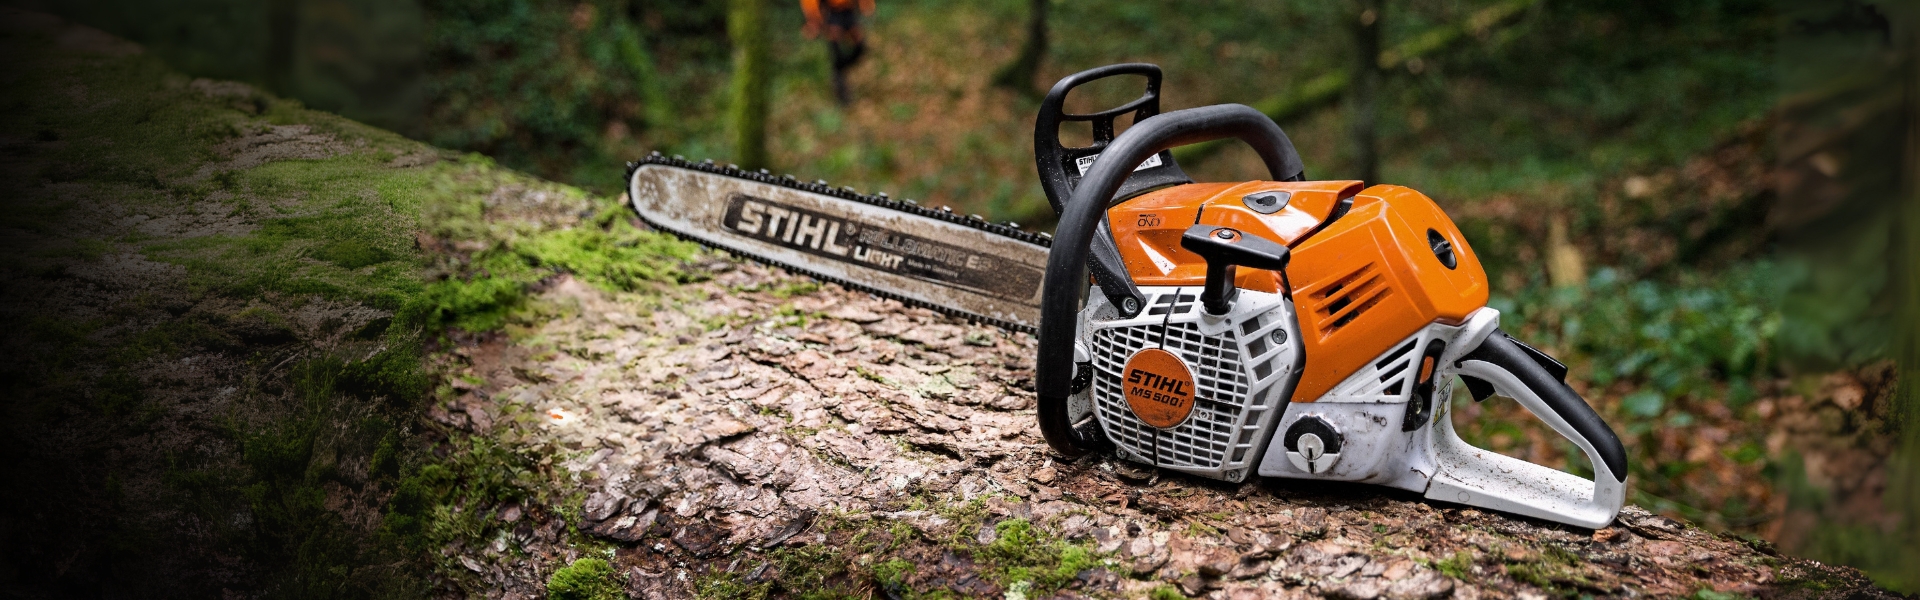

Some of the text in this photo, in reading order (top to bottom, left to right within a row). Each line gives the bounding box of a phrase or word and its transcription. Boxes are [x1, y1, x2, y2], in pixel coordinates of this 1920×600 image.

[737, 200, 848, 257] STIHL
[853, 245, 904, 270] LIGHT
[1128, 368, 1187, 396] STIHL
[1131, 387, 1184, 407] MS 500i
